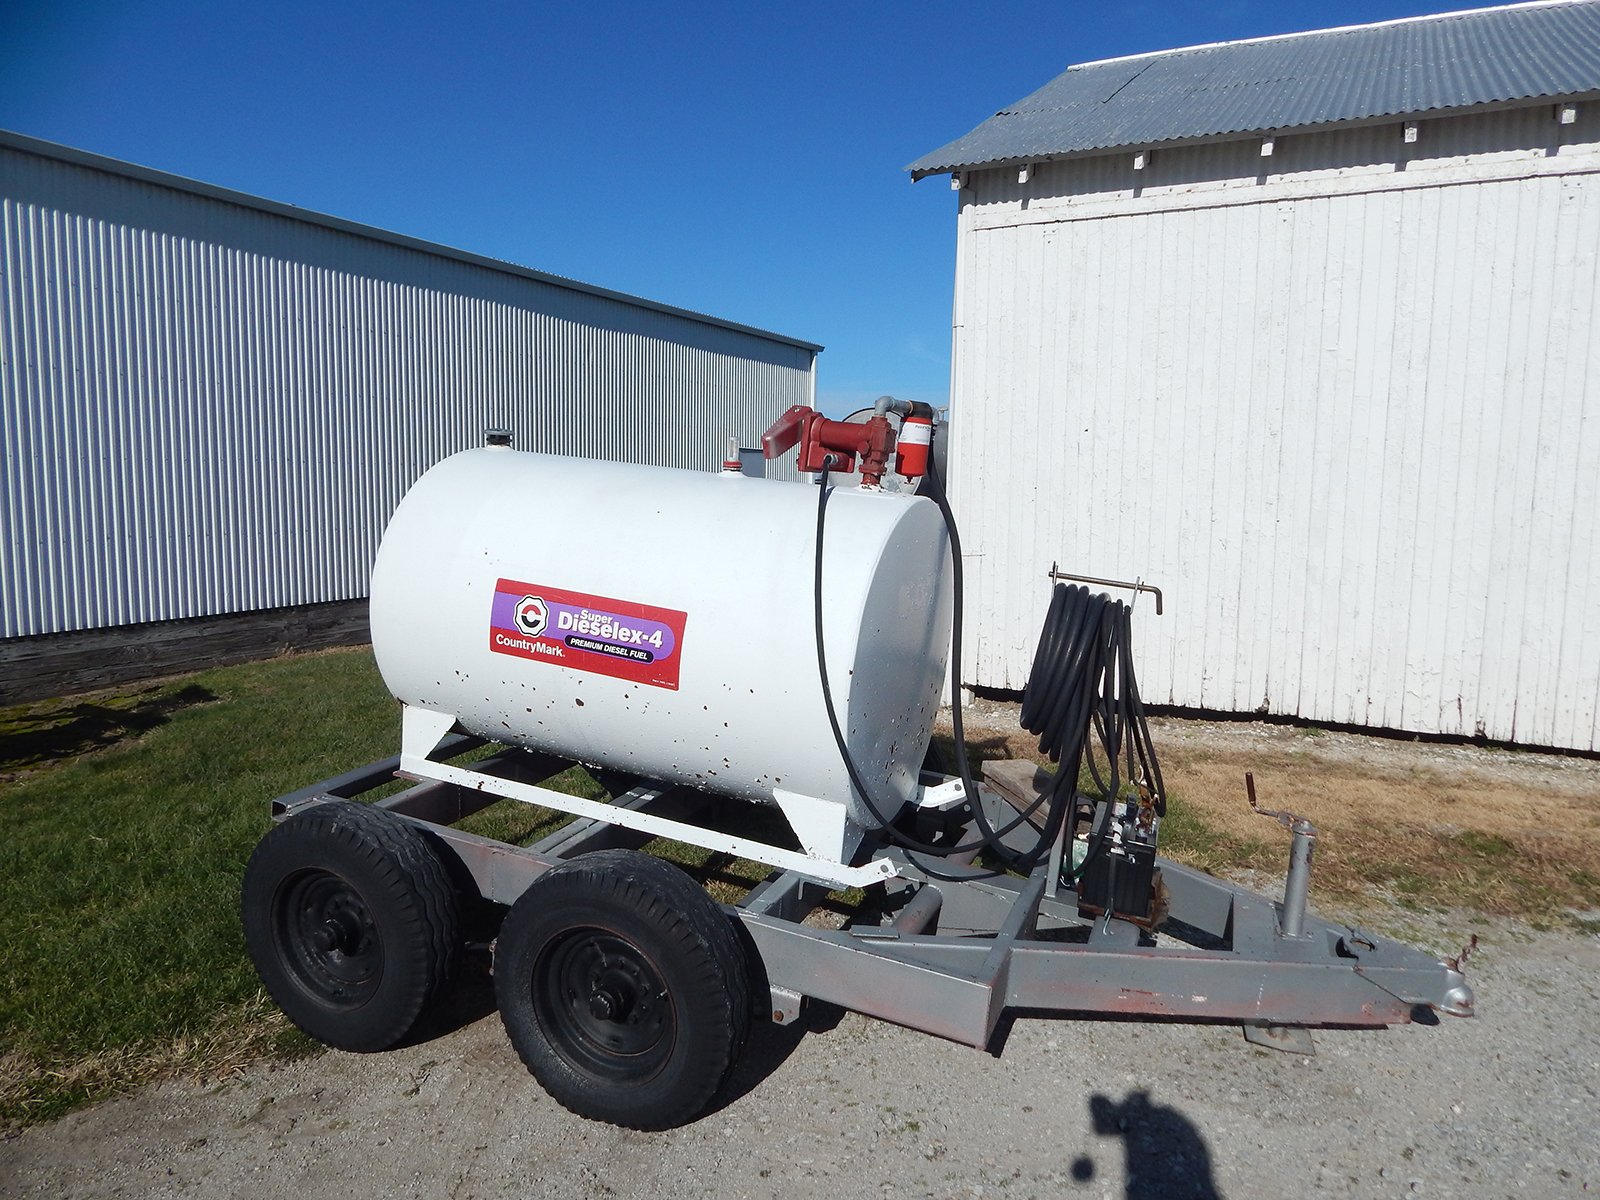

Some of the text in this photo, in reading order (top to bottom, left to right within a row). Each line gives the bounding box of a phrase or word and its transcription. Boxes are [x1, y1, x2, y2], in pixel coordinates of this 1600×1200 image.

[580, 609, 613, 626] Super
[557, 611, 663, 649] Dieselex-4
[570, 637, 648, 661] PREMIUM DIESEL FUEL
